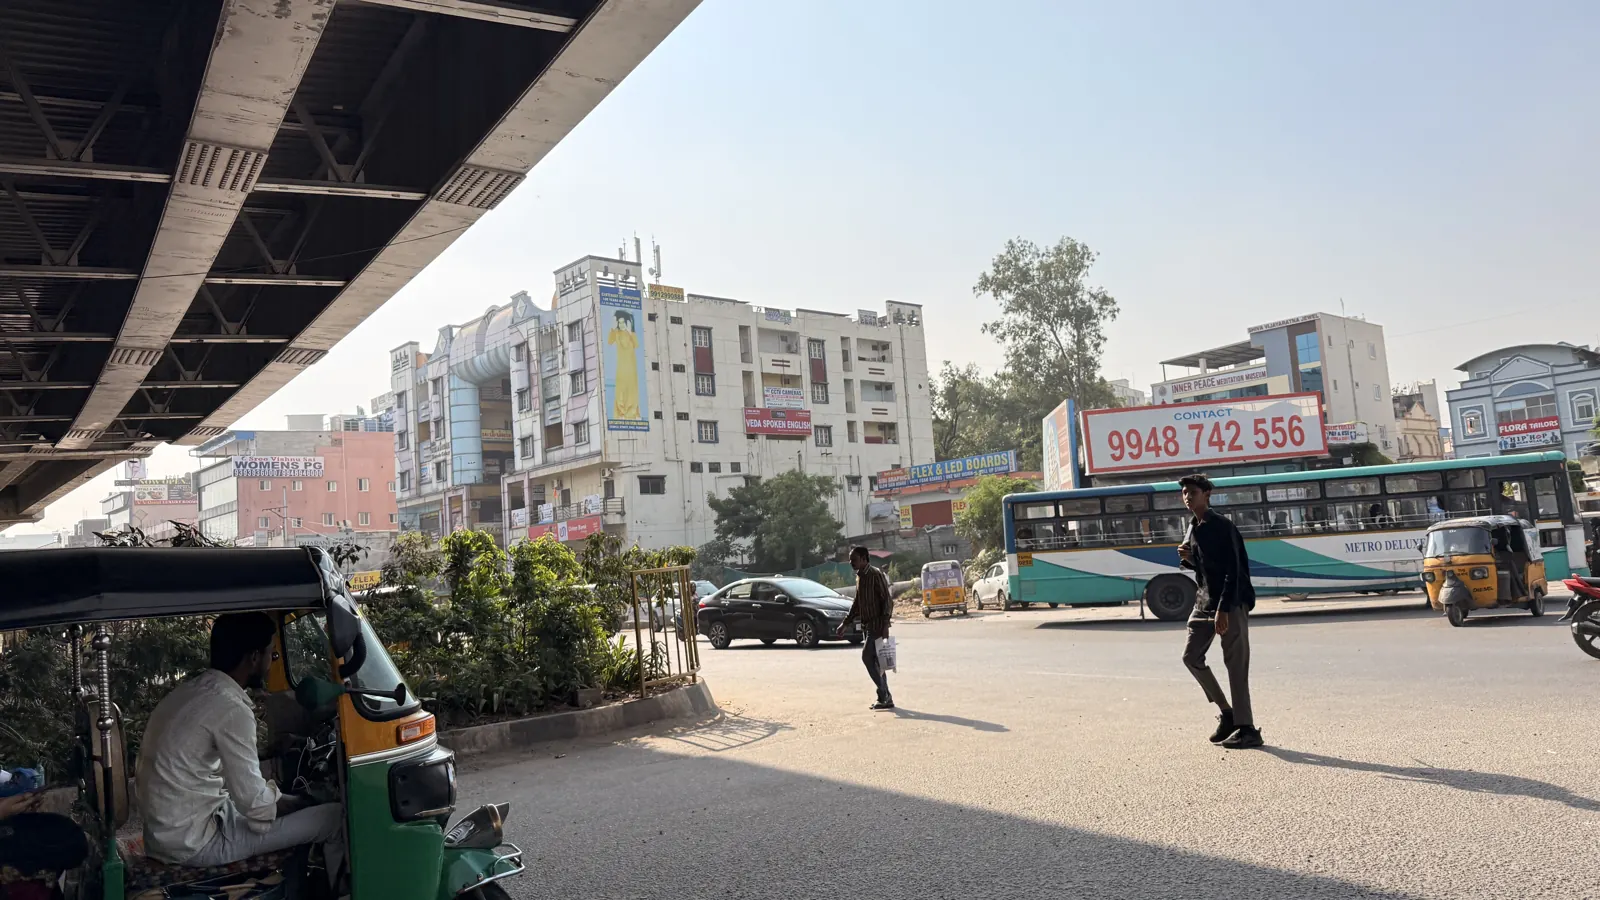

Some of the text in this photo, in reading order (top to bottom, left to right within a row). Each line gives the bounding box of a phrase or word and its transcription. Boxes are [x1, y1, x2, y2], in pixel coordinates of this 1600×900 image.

[1171, 370, 1267, 394] INNER PEACE MEDITATION MUSEUM
[1173, 408, 1233, 421] CONTACT
[746, 418, 811, 430] VEDA SPOKEN ENGLISH
[1498, 419, 1559, 434] FLORA TAILORS
[1107, 425, 1180, 462] 9948
[1187, 419, 1244, 455] 742
[1253, 414, 1306, 450] 556
[1510, 432, 1548, 443] HIP HOP
[235, 461, 323, 470] WOMENS PG
[911, 465, 933, 479] FLEX
[935, 464, 943, 475] &
[944, 460, 964, 474] LED
[966, 452, 1008, 470] BOARDS
[900, 507, 910, 516] FLEX
[1345, 537, 1428, 554] METRO DELUXE
[354, 575, 375, 584] FLEX
